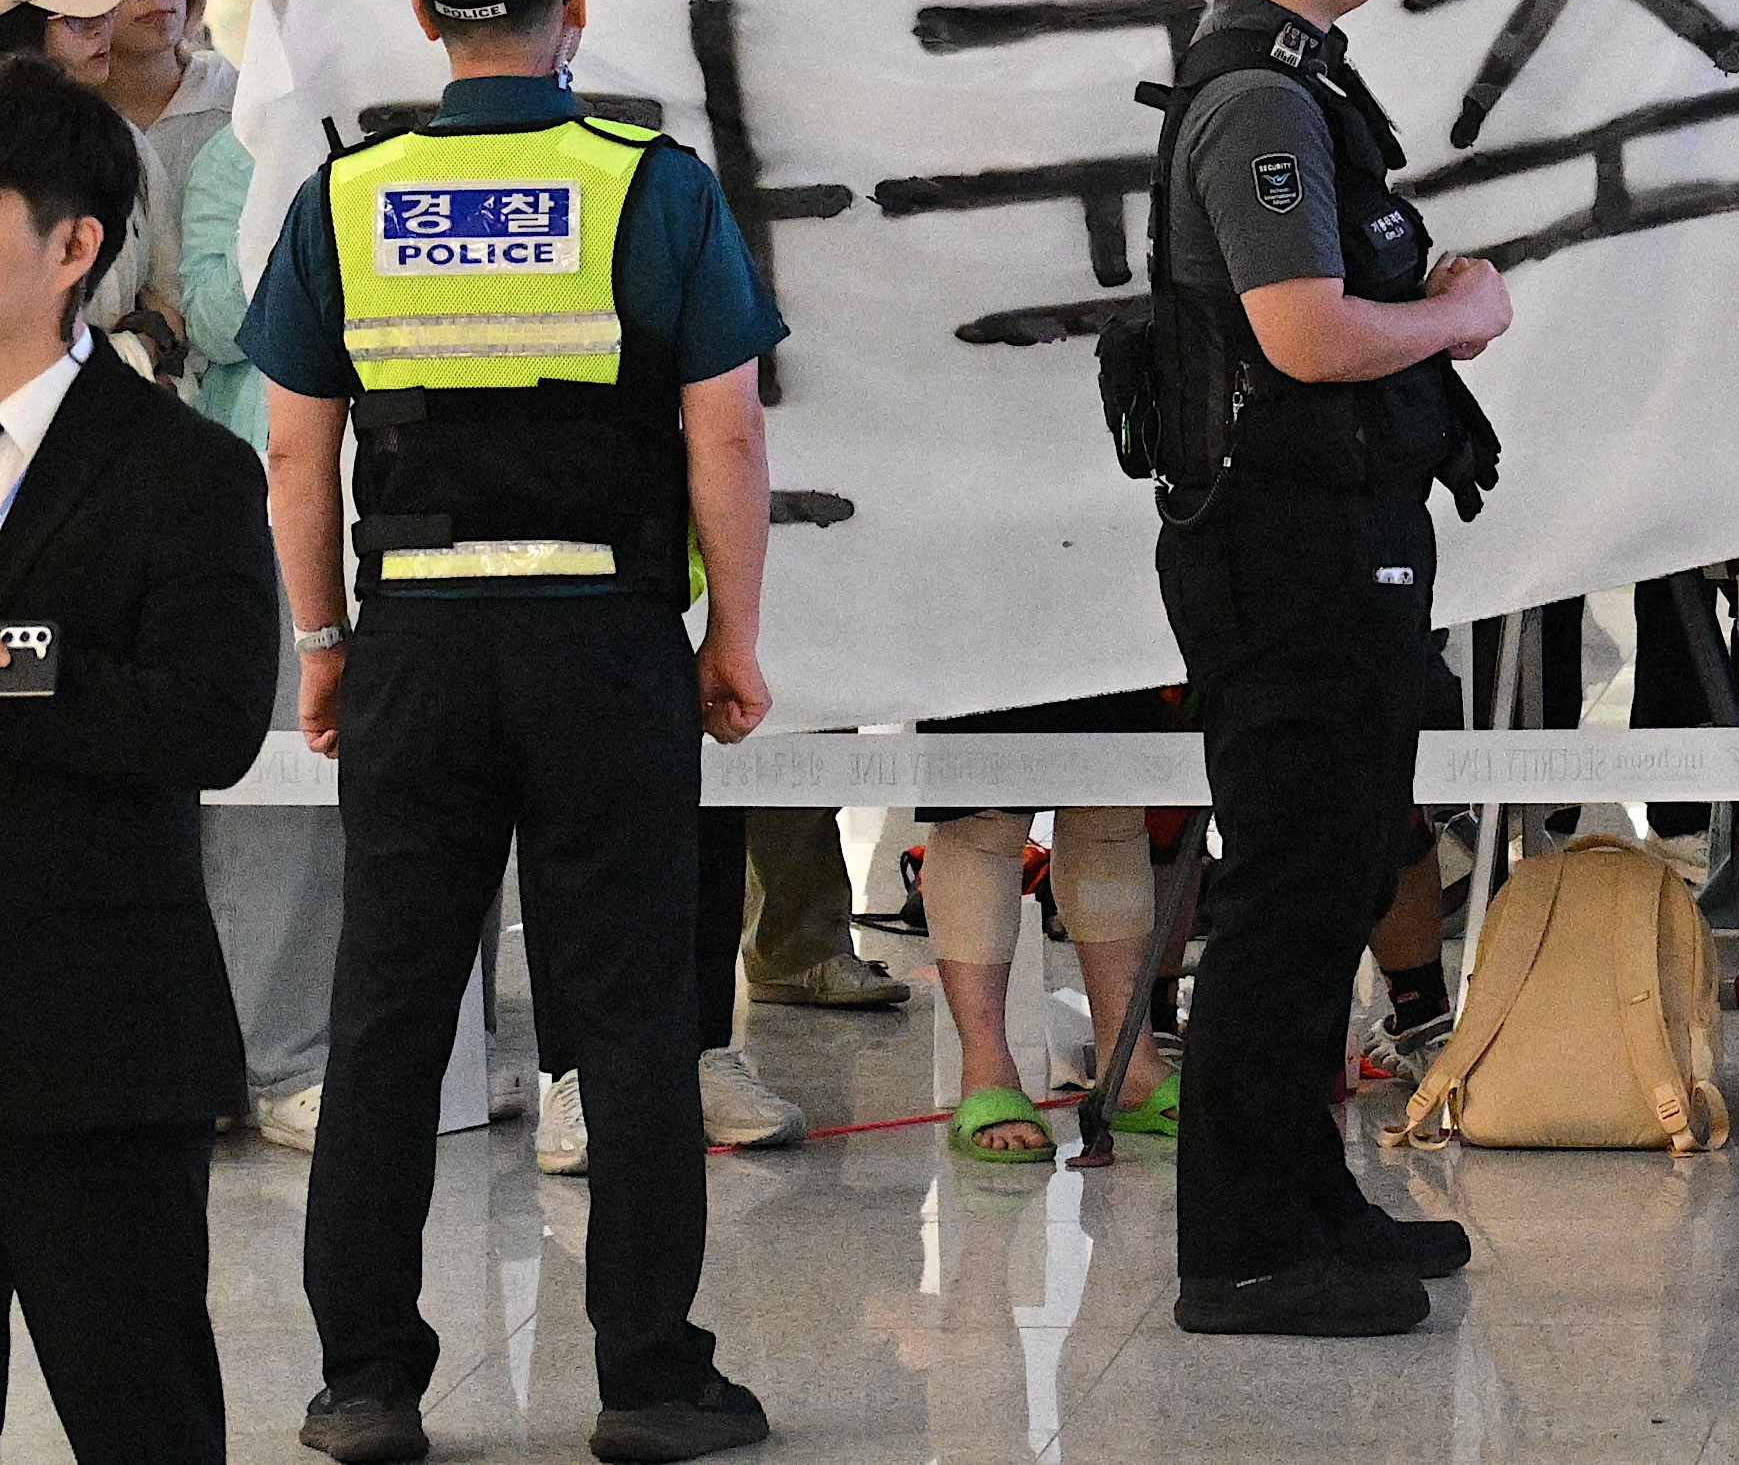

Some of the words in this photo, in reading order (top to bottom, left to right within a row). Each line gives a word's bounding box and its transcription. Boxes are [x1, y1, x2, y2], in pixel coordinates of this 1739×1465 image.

[443, 6, 501, 18] POLICE
[1258, 162, 1292, 173] SECURITY
[398, 243, 554, 266] POLICE
